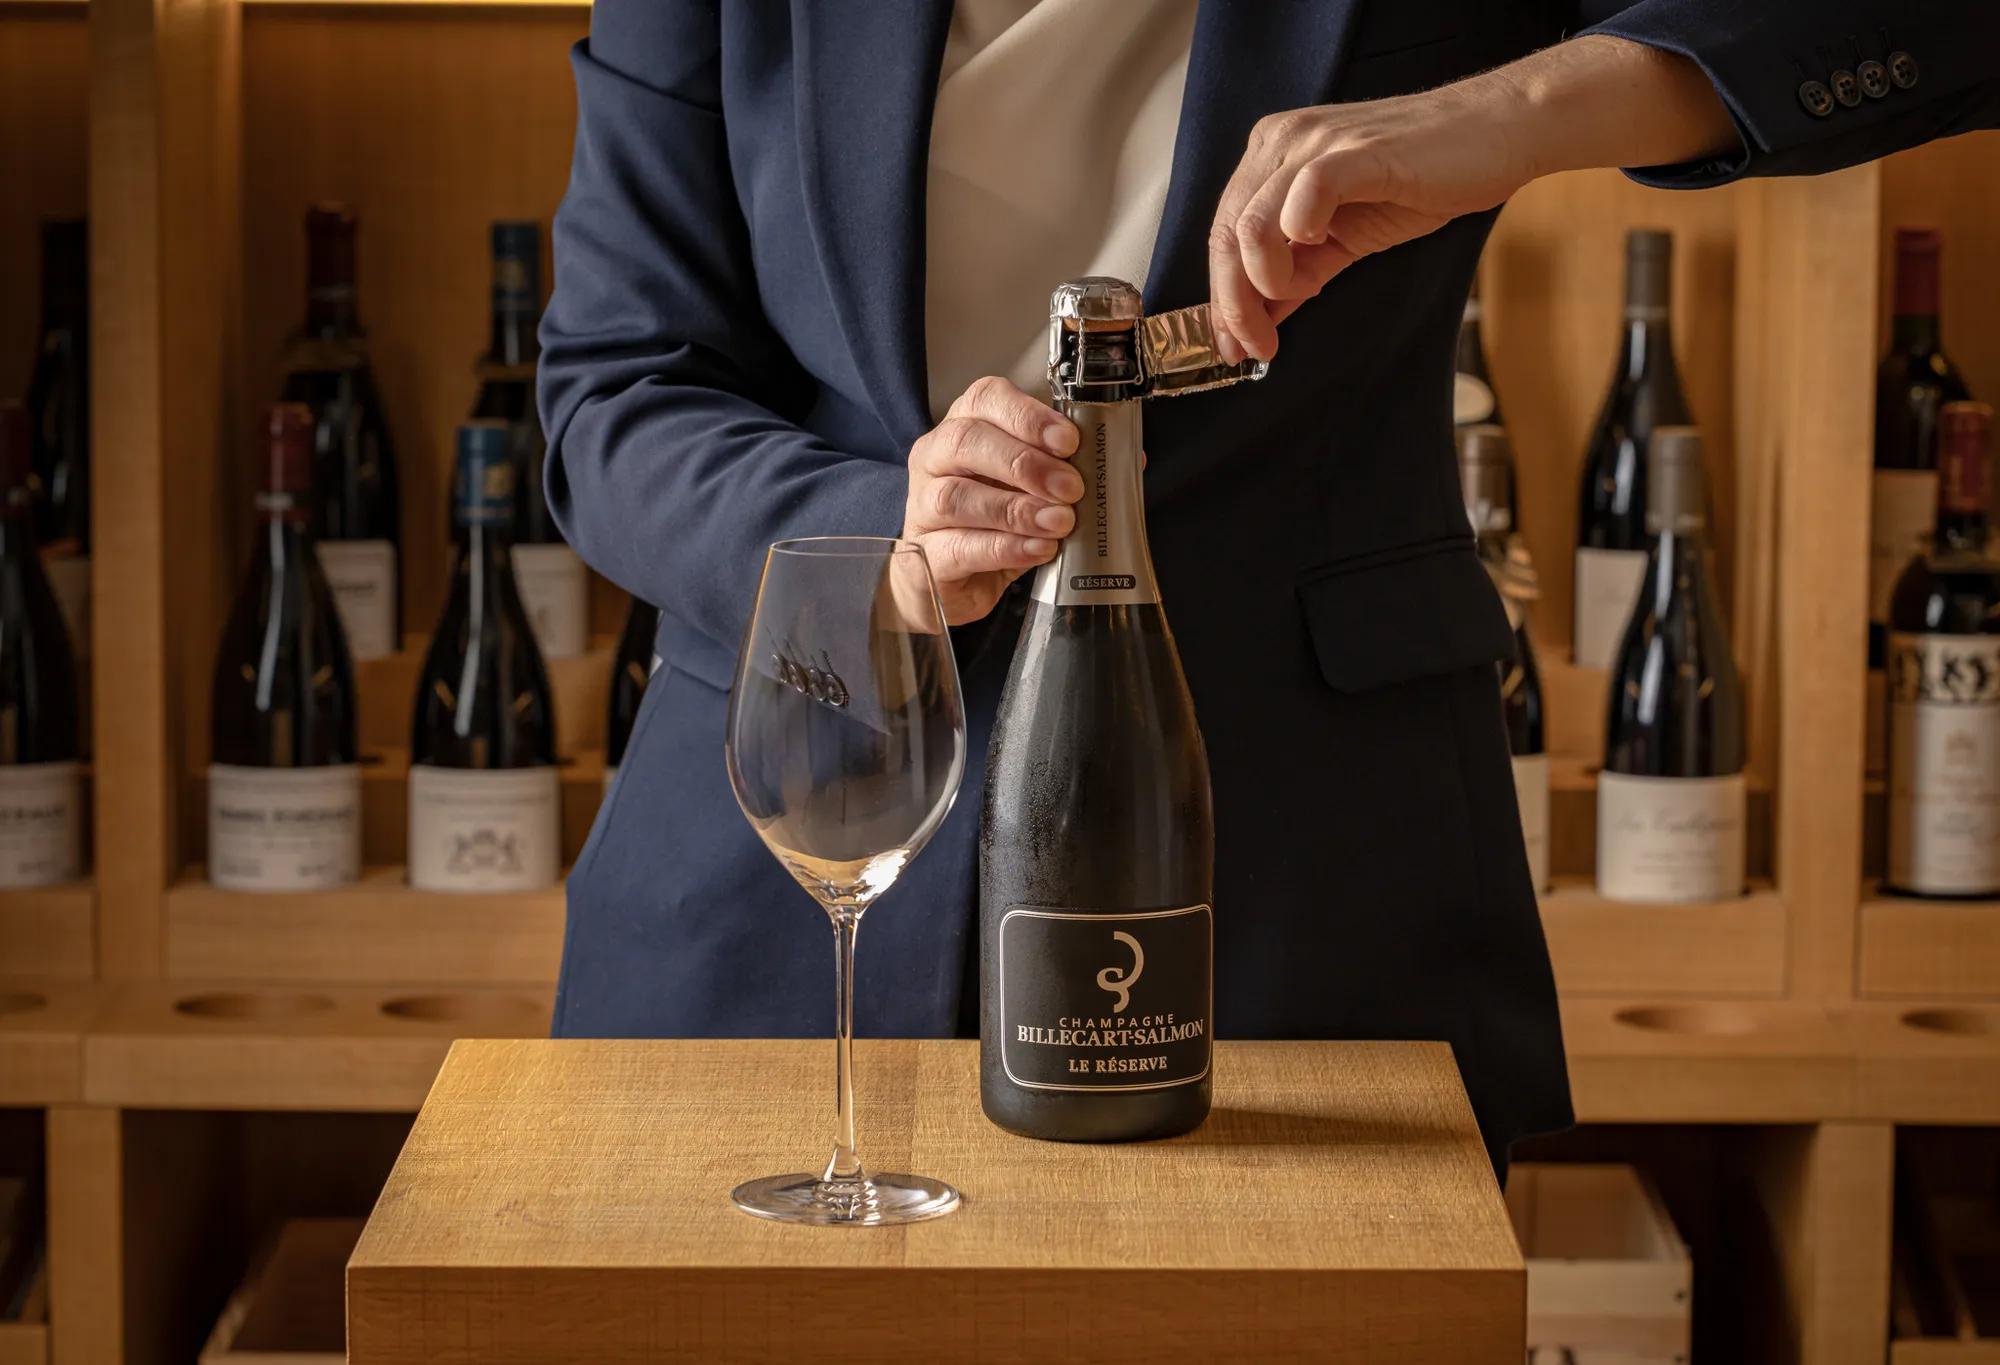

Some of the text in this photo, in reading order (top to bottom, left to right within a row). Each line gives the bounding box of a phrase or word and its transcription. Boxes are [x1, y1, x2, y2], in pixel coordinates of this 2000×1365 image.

[1096, 422, 1108, 558] BILLECART-SALMON
[1078, 576, 1130, 588] RÉSERVE
[1059, 1014, 1174, 1028] CHAMPAGNE
[1017, 1019, 1204, 1047] BILLECART-SALMON
[1069, 1056, 1168, 1073] LE RÉSERVE
